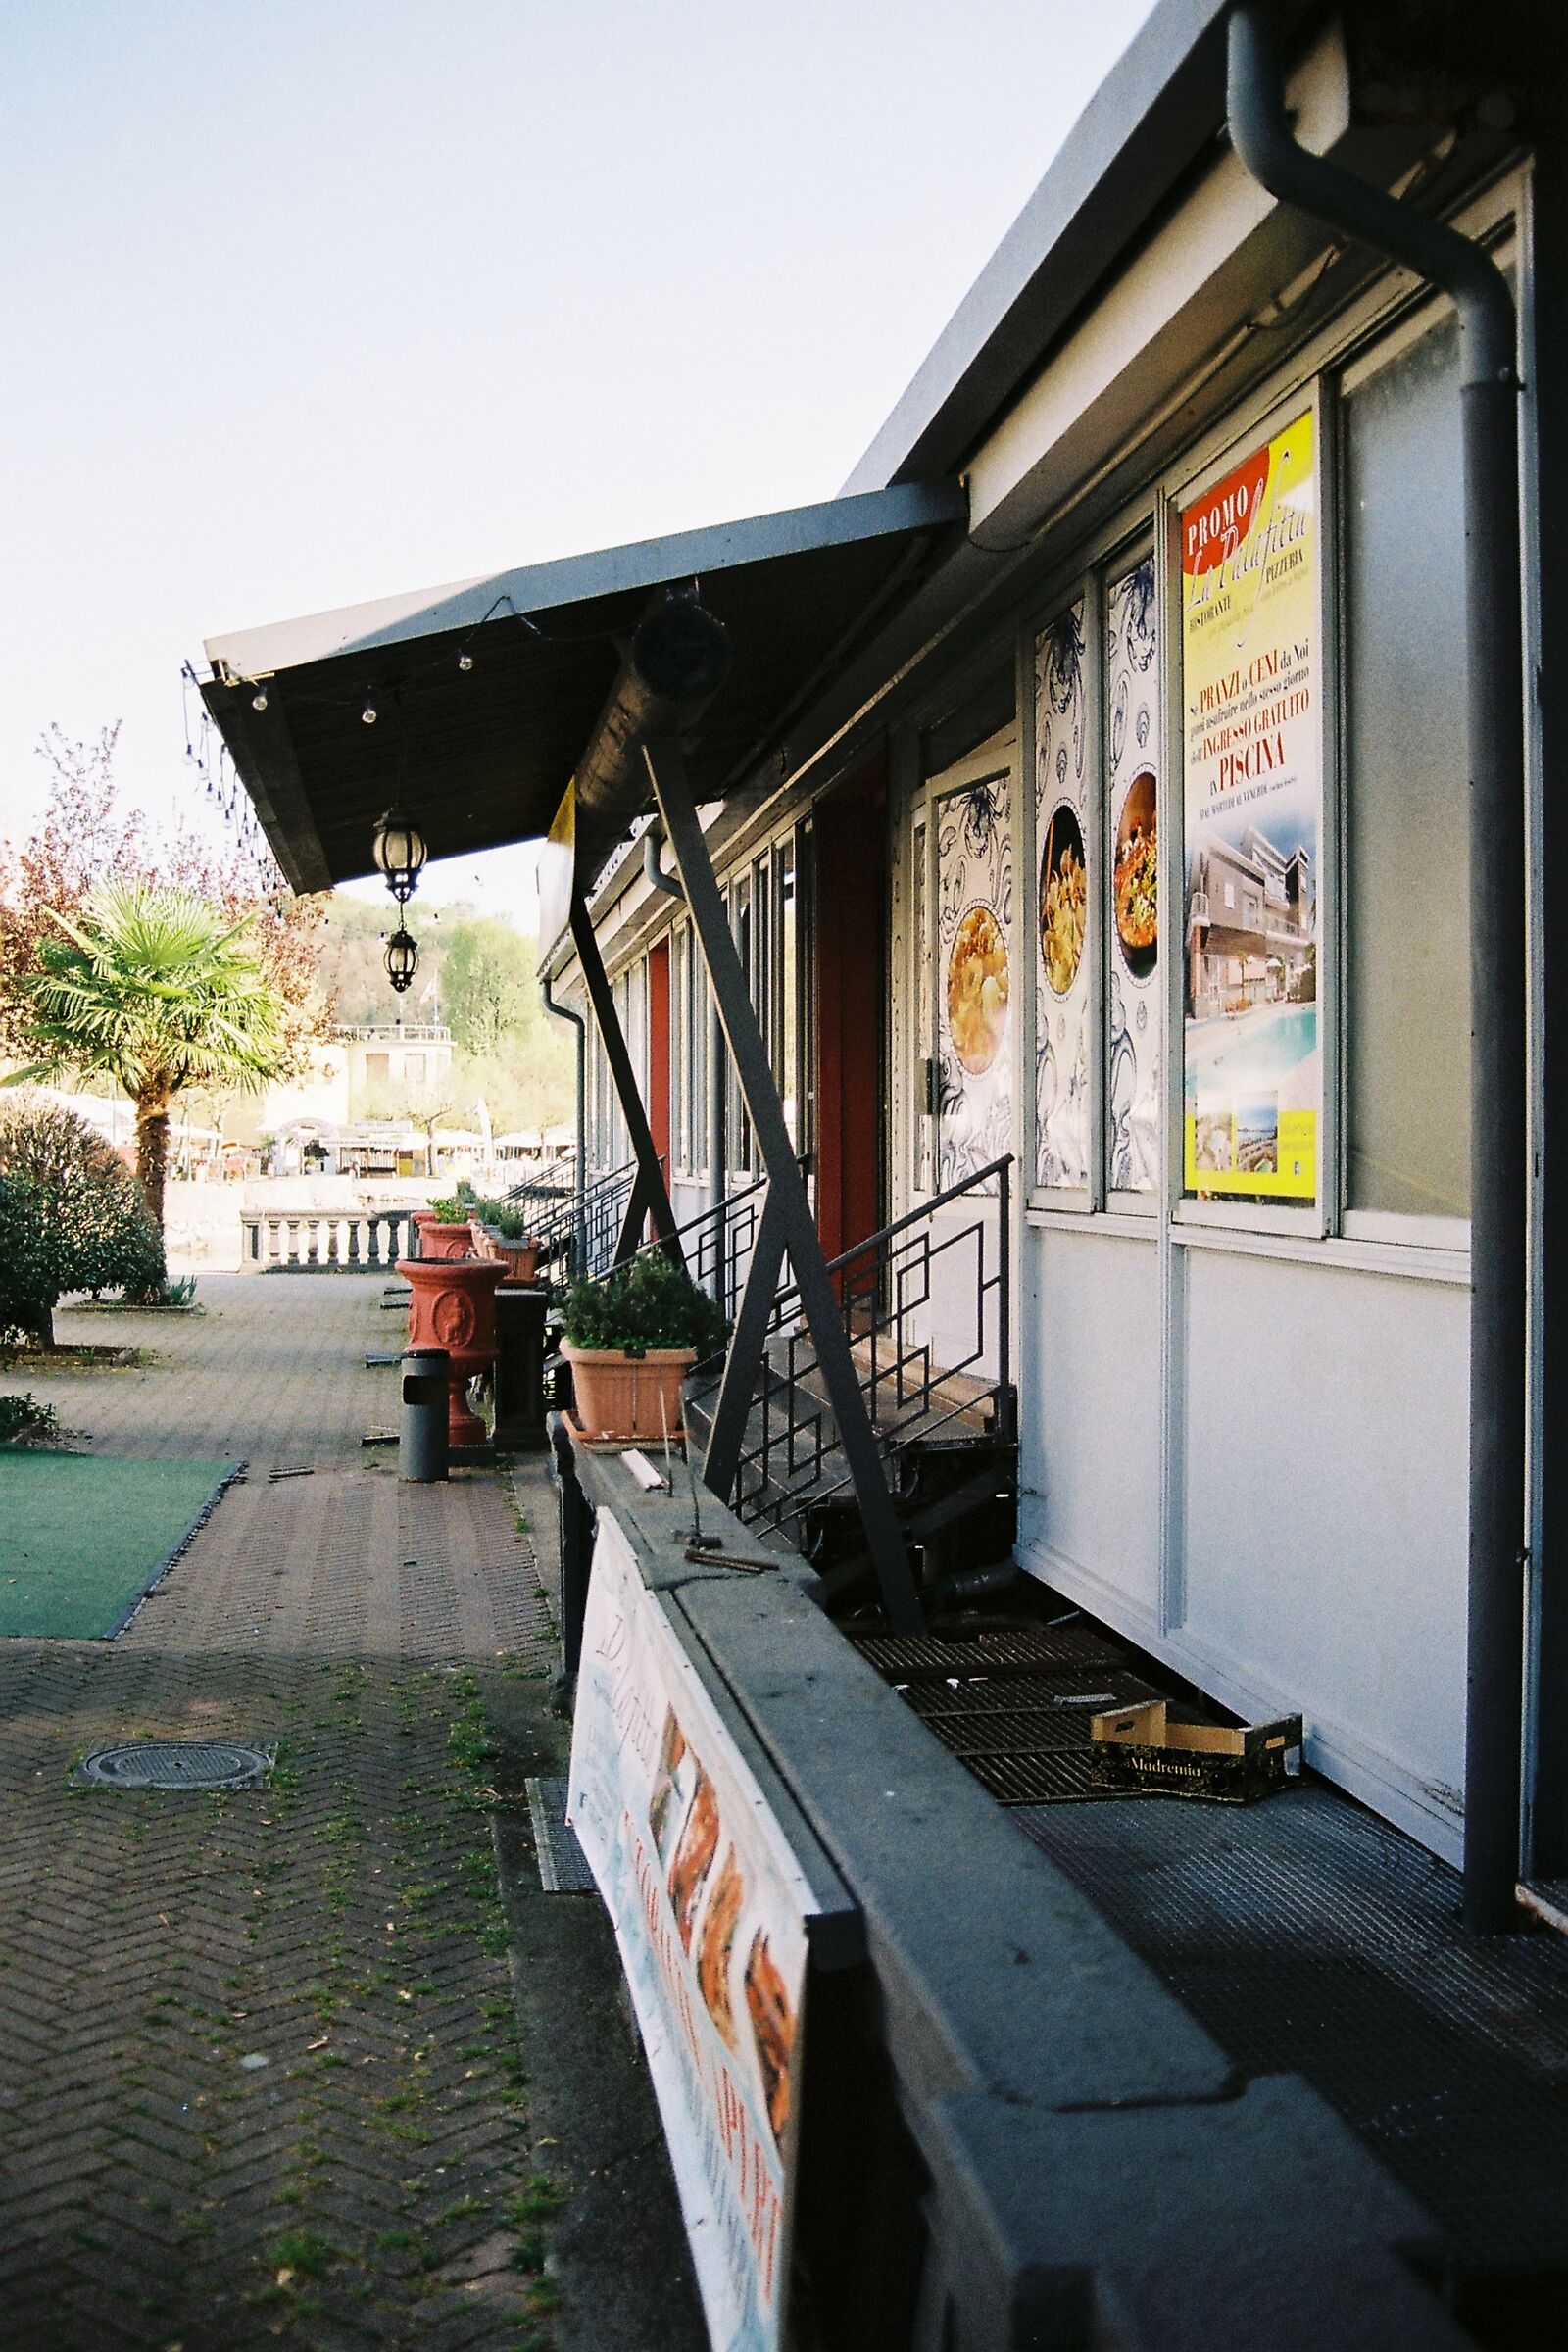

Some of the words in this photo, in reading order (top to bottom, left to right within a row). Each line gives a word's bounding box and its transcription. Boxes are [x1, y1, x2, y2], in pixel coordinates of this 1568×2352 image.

[1188, 485, 1249, 556] PROMO
[1187, 549, 1214, 612] La
[1265, 549, 1303, 584] PIZZERIA
[1200, 670, 1240, 714] PRANZI
[1249, 649, 1278, 687] CENI
[1280, 650, 1292, 670] da
[1294, 638, 1309, 662] Noi
[1283, 666, 1310, 692] giorno
[1254, 688, 1310, 733] GRATUITO
[1219, 731, 1286, 791] PISCINA
[1130, 1757, 1200, 1778] Madremia
